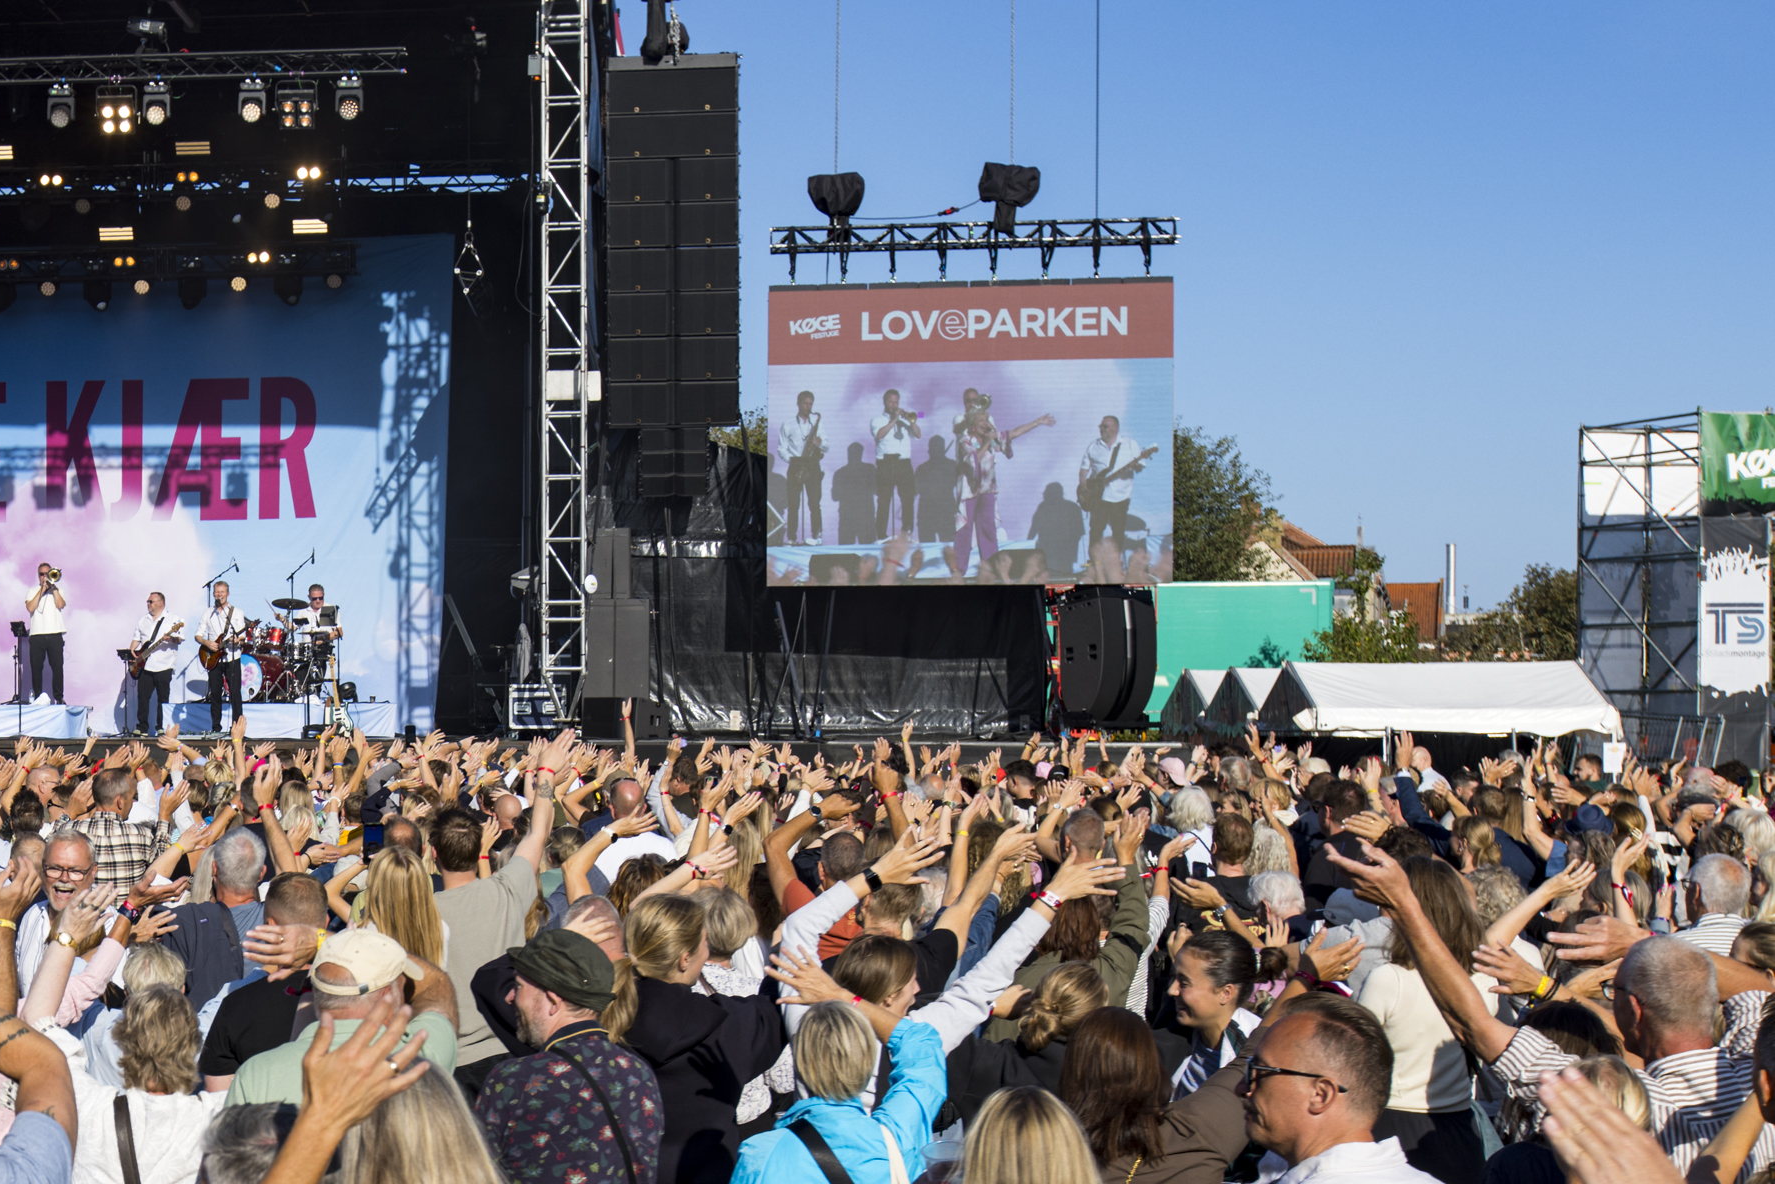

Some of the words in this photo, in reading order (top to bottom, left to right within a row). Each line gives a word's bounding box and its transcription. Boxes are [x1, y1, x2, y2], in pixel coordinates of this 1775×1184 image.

[789, 314, 841, 336] KØGE
[46, 376, 317, 522] KJÆR
[1705, 603, 1765, 645] TS
